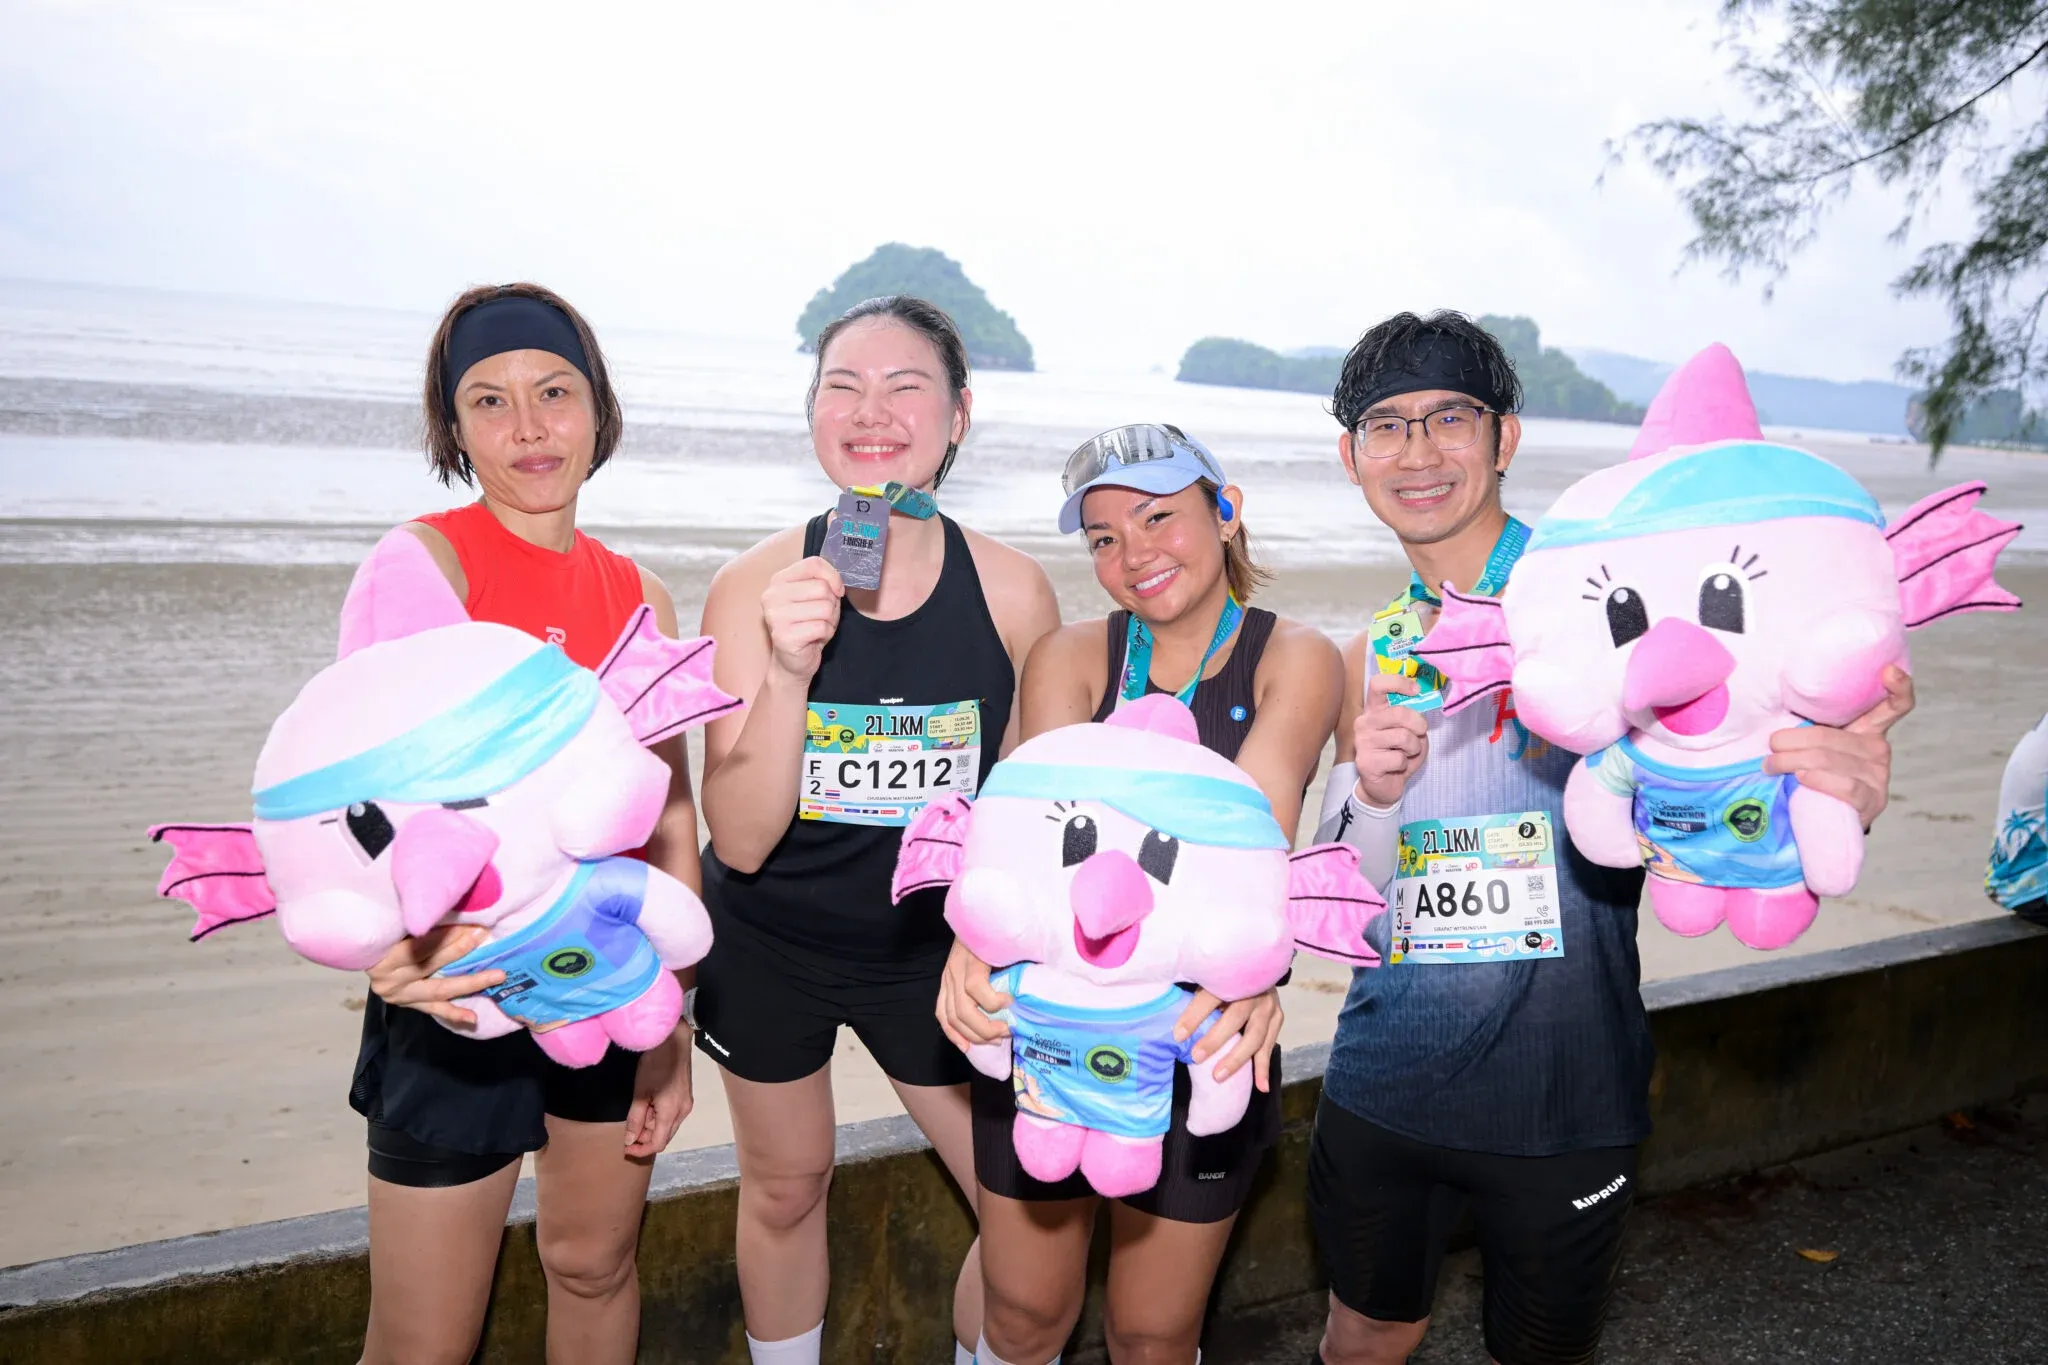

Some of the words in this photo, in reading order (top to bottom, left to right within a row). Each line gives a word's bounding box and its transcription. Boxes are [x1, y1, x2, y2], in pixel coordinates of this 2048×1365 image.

[864, 715, 923, 737] 21.1KM
[810, 760, 822, 775] F
[838, 757, 952, 789] C1212
[810, 780, 821, 795] 2
[1422, 827, 1481, 854] 21.1KM
[1396, 887, 1404, 906] M
[1415, 879, 1510, 918] A860
[1396, 912, 1403, 930] 3
[1198, 1171, 1226, 1180] BANDIT
[1572, 1174, 1627, 1210] KIPRUN
